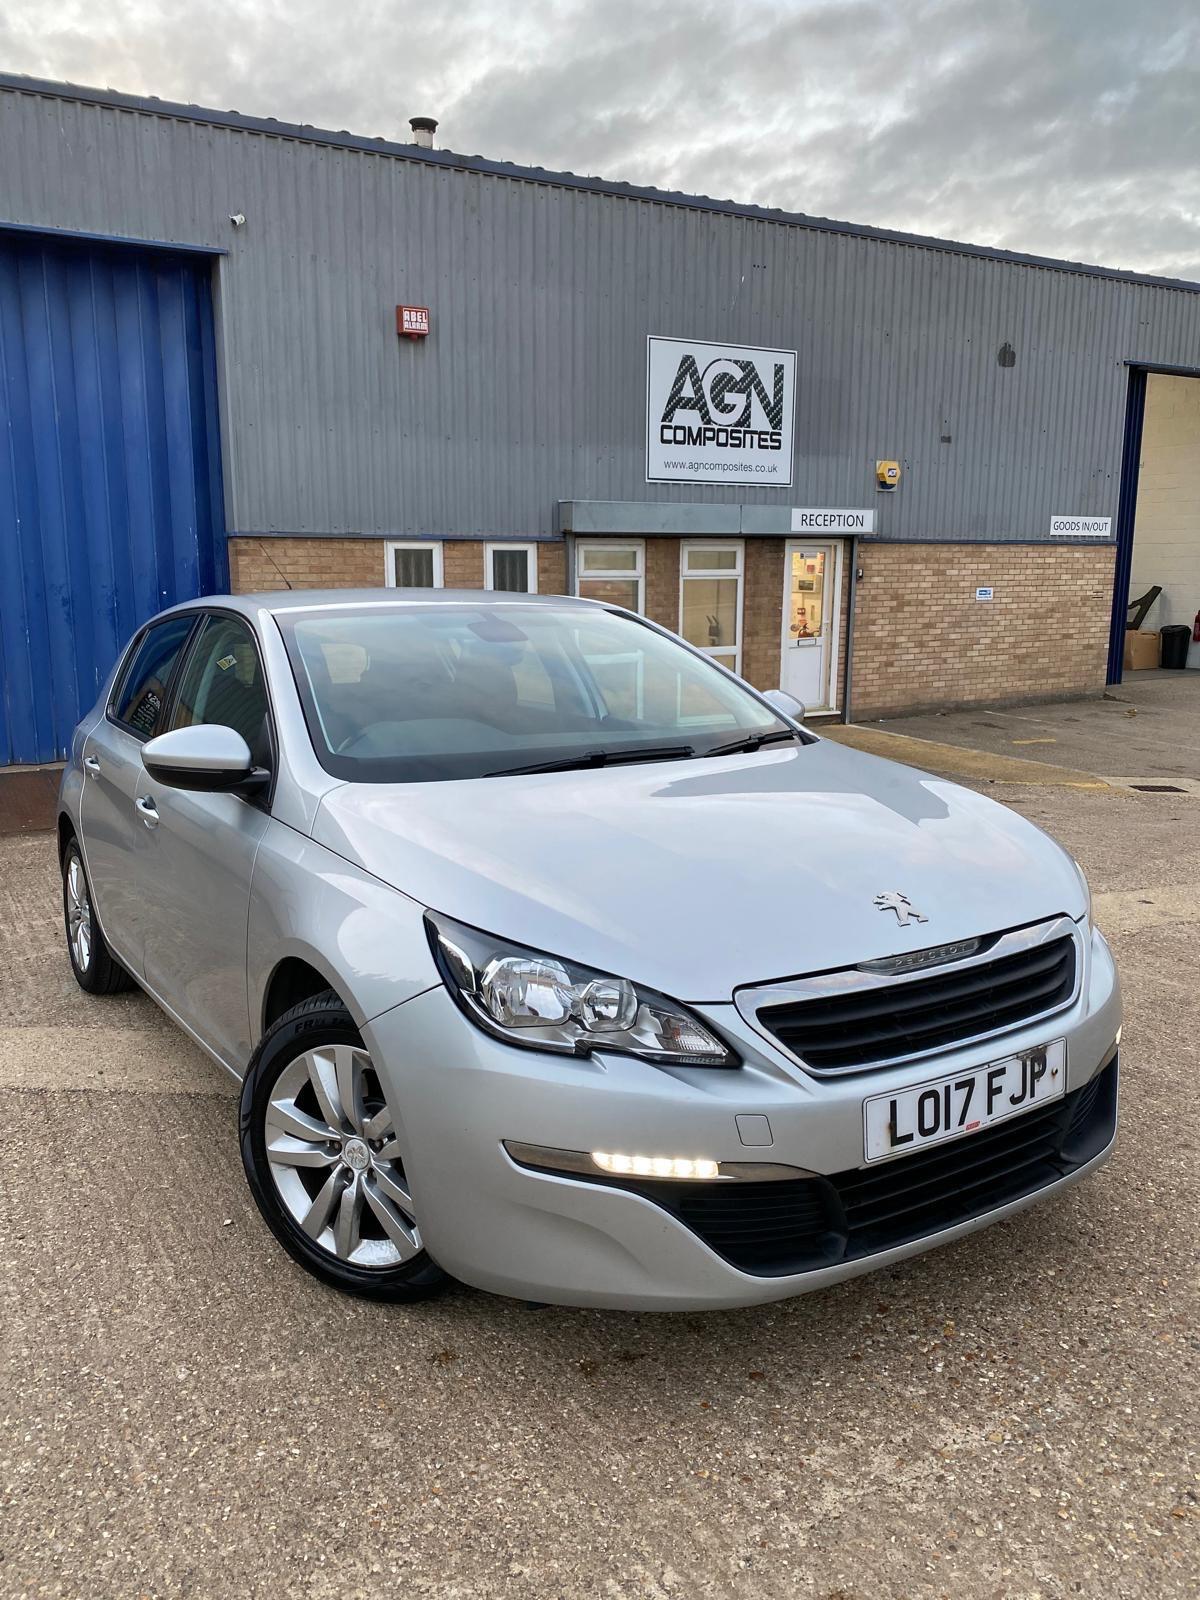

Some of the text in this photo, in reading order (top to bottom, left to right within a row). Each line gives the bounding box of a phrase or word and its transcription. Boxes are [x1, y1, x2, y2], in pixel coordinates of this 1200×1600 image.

[404, 310, 427, 322] ABEL
[404, 321, 428, 330] ALARM
[661, 355, 784, 430] AGN
[660, 424, 782, 450] COMPOSITES
[664, 460, 778, 473] www.agncomposites.co.uk
[801, 514, 864, 527] RECEPTION
[1053, 521, 1108, 532] GOODS IN/OUT
[896, 944, 967, 967] PEUGEOT
[889, 1052, 1047, 1147] LO17 FJP
